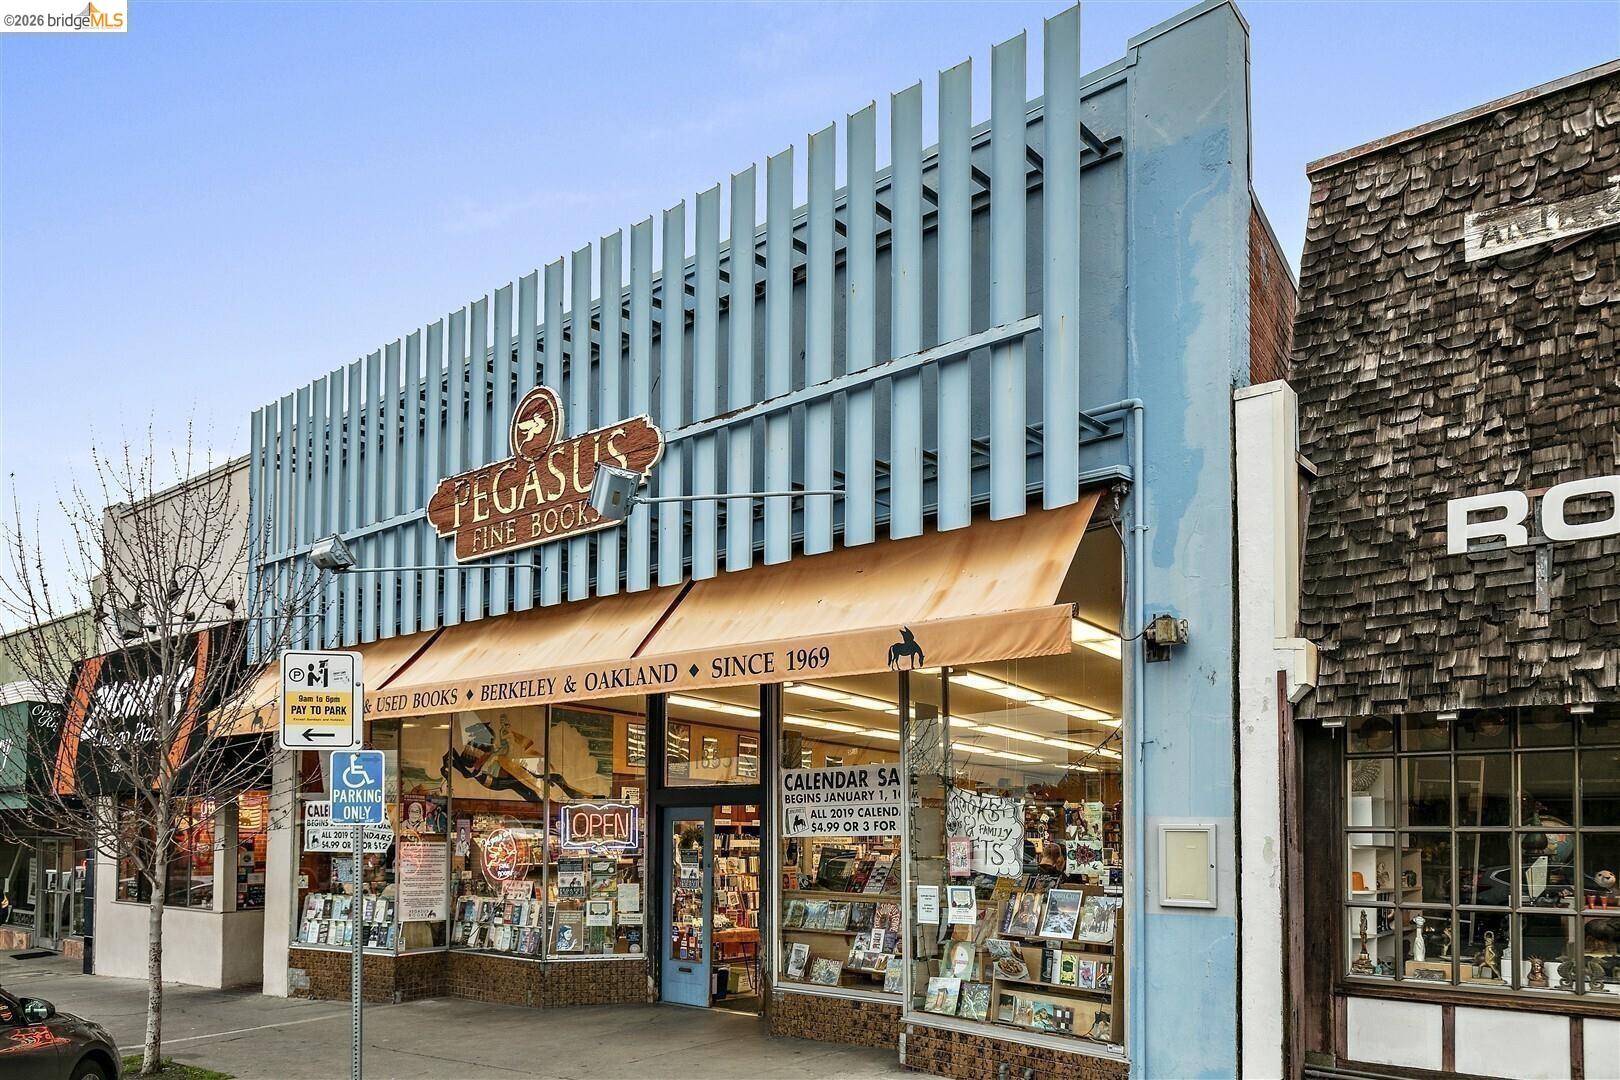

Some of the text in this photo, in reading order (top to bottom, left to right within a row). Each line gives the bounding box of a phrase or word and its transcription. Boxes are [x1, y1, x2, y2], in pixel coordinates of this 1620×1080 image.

[453, 428, 627, 528] PEGASUS
[1447, 475, 1620, 554] RO
[472, 519, 517, 553] FINE
[376, 695, 407, 712] USED
[412, 688, 458, 709] BOOKS
[480, 677, 557, 701] BERKELEY
[564, 675, 577, 693] &
[585, 663, 678, 691] OAKLAND
[711, 652, 775, 679] SINCE
[786, 646, 830, 671] 1969
[298, 695, 313, 703] 9am
[316, 695, 323, 703] to
[291, 705, 347, 715] PAY TO PARK
[784, 770, 868, 791] CALENDAR
[333, 789, 382, 803] PARKING
[785, 793, 821, 804] BEGINS
[824, 791, 875, 803] JANUARY
[879, 790, 888, 801] 1,
[308, 805, 330, 817] CALE
[343, 806, 372, 820] ONLY
[811, 810, 827, 819] ALL
[830, 808, 854, 818] 2019
[858, 807, 901, 817] CALEND
[307, 819, 329, 827] BEGINS
[572, 812, 629, 838] OPEN
[811, 821, 896, 833] $4.99 OR 3 FOR
[322, 831, 332, 839] ALL
[333, 831, 348, 839] 2019
[979, 824, 1012, 841] FAMILY
[322, 841, 340, 849] $4.99
[342, 841, 351, 849] OR
